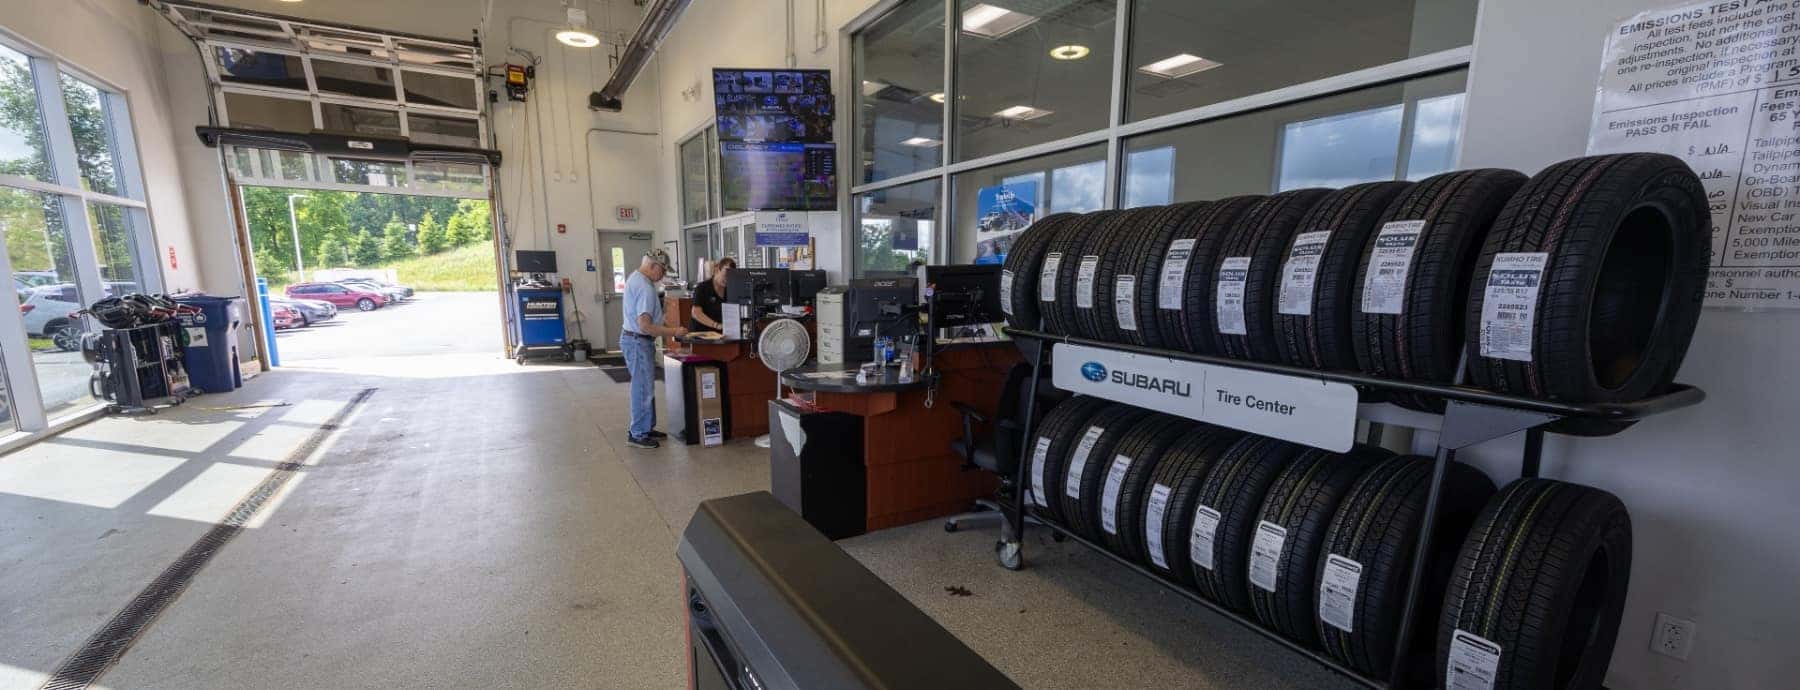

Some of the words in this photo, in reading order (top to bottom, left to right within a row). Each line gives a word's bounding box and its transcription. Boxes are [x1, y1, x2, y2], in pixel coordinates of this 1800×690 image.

[1620, 9, 1703, 35] EMISSIONS
[1709, 0, 1749, 14] TEST
[1647, 28, 1661, 40] All
[1664, 24, 1685, 37] test
[1688, 20, 1713, 31] fees
[1717, 9, 1762, 24] include
[1766, 3, 1788, 14] the
[1697, 28, 1716, 40] but
[1718, 23, 1739, 36] not
[1742, 18, 1763, 31] the
[1766, 12, 1796, 25] cost
[1695, 39, 1712, 50] No
[1715, 27, 1777, 49] additional
[1617, 64, 1638, 75] one
[1667, 60, 1710, 77] original
[1713, 49, 1777, 71] inspection
[1782, 46, 1795, 56] at
[1628, 82, 1643, 93] All
[1645, 77, 1678, 92] prices
[1682, 69, 1725, 84] include
[1728, 68, 1736, 76] a
[1740, 57, 1797, 75] Program
[1737, 75, 1751, 86] of
[1760, 101, 1794, 113] Fees
[1608, 114, 1668, 131] Emissions
[1671, 105, 1738, 123] Inspection
[1770, 112, 1787, 122] 65
[1625, 126, 1657, 138] PASS
[1660, 123, 1680, 134] OR
[1683, 119, 1711, 131] FAIL
[1747, 186, 1789, 200] (OBD)
[1740, 199, 1780, 210] Visual
[1738, 213, 1767, 223] New
[1771, 211, 1795, 221] Car
[1733, 237, 1768, 248] 5,000
[1729, 289, 1781, 300] Number
[1111, 370, 1190, 397] SUBARU
[1216, 389, 1241, 406] Tire
[1245, 395, 1296, 416] Center
